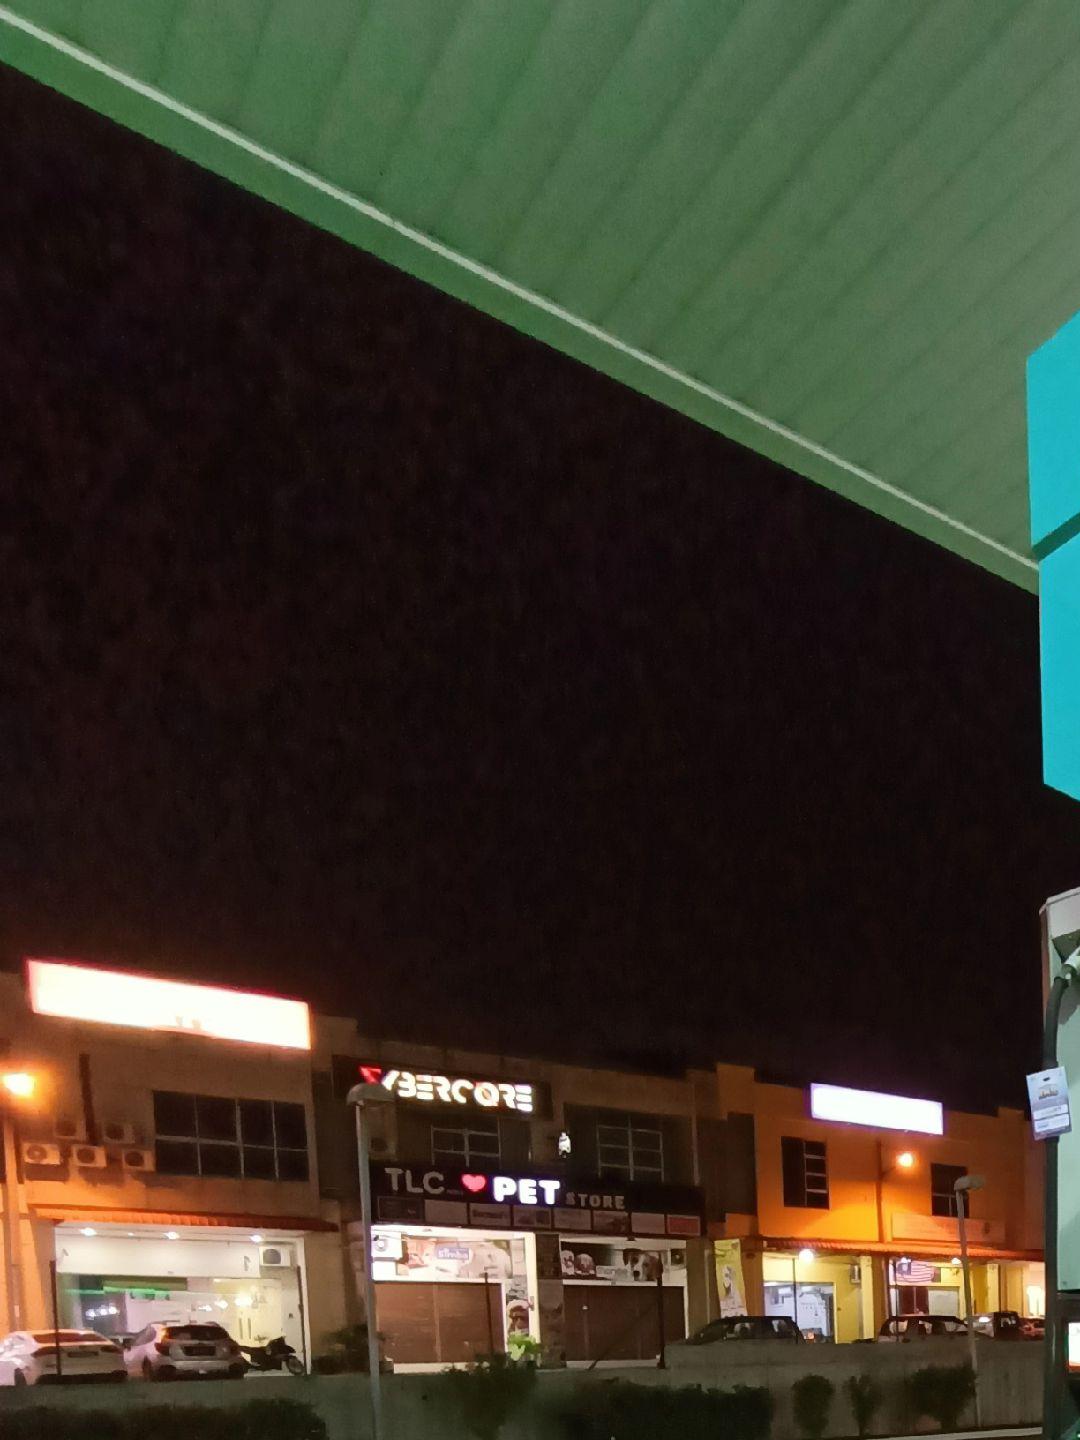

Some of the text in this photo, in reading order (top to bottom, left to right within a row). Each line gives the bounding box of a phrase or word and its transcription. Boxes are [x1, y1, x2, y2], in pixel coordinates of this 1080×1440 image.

[384, 1168, 625, 1209] TLC PET STORE
